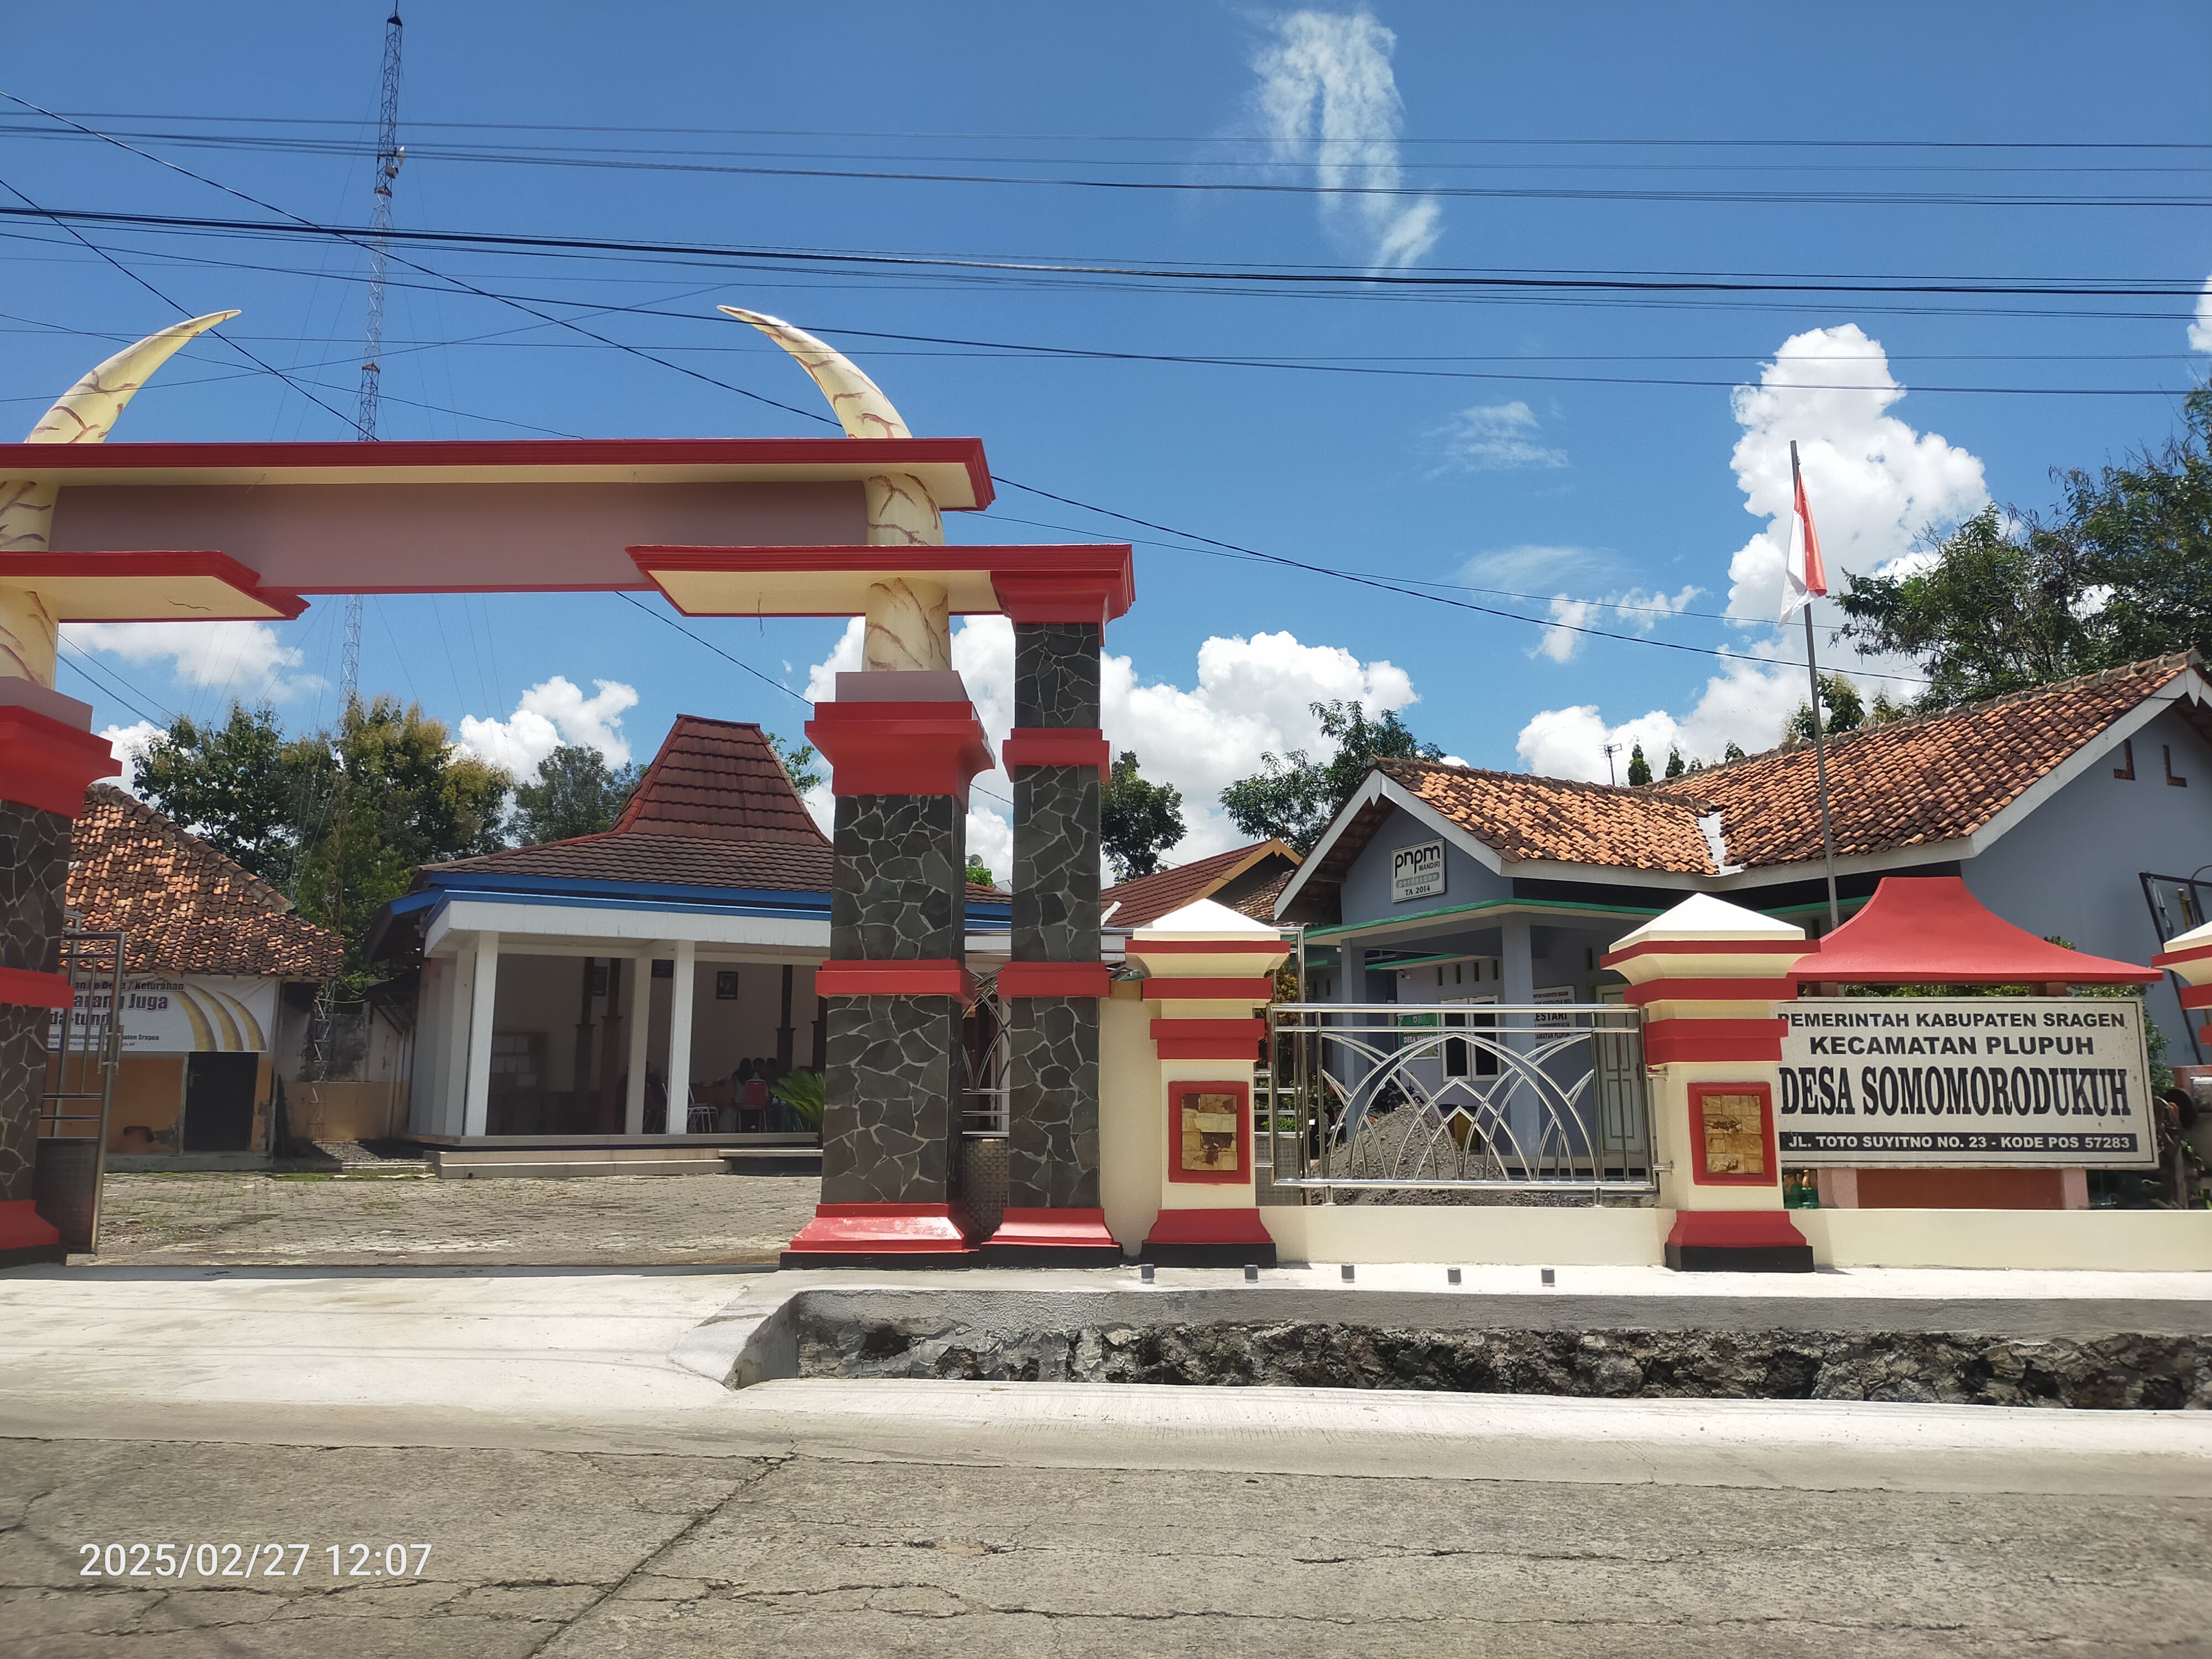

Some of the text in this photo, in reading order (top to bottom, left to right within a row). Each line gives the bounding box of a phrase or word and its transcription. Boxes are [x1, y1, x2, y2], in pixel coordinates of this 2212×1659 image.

[1418, 860, 1441, 872] MANDIRI
[1399, 874, 1437, 889] perdesaan
[1415, 885, 1431, 894] 2014
[134, 982, 184, 990] Kelurahan
[128, 993, 169, 1011] Juga
[1534, 1013, 1568, 1021] ESTARI
[1916, 1013, 2037, 1027] KABUPATEN
[2043, 1013, 2125, 1027] SRAGEN
[1809, 1036, 2094, 1055] KECAMATAN PLUPUH
[1778, 1066, 2131, 1117] DESA SOMOMORODUKUH
[1788, 1136, 1811, 1147] JL.
[1815, 1136, 1858, 1147] TOTO
[1863, 1136, 1932, 1148] SUYITNO
[1937, 1136, 1964, 1148] NO.
[1969, 1137, 1987, 1148] 23
[2001, 1136, 2044, 1149] KODE
[2048, 1137, 2079, 1149] POS
[2085, 1137, 2130, 1149] 57283
